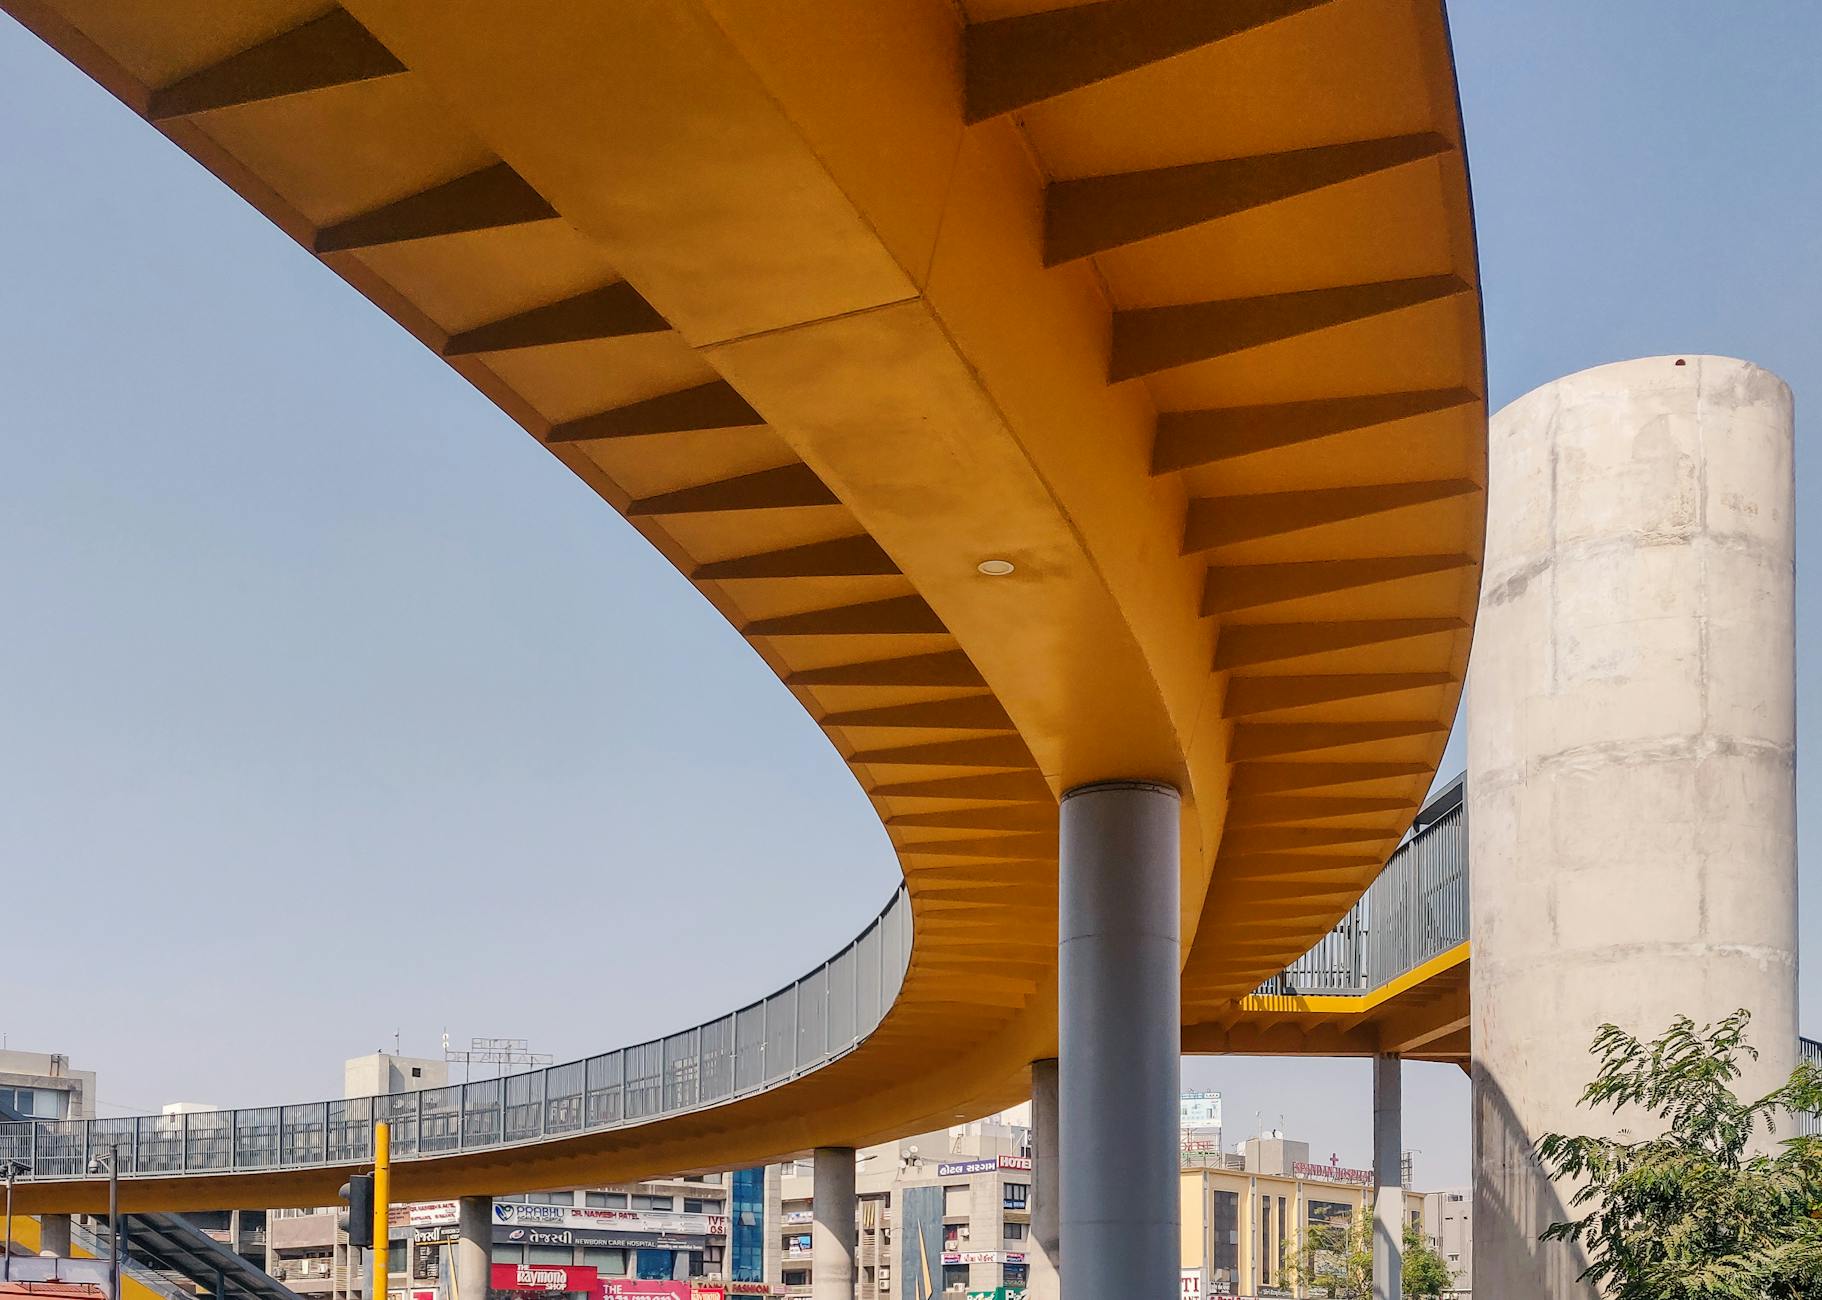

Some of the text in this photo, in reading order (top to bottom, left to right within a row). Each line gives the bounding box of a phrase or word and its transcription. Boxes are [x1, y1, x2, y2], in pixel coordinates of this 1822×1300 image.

[1000, 1157, 1031, 1169] HOTE
[1295, 1162, 1333, 1177] SPANDAN
[517, 1206, 564, 1217] PRABHU
[619, 1212, 639, 1220] PATEL
[708, 1216, 724, 1225] IVF
[603, 1285, 622, 1294] THE
[732, 1284, 768, 1293] FASHION
